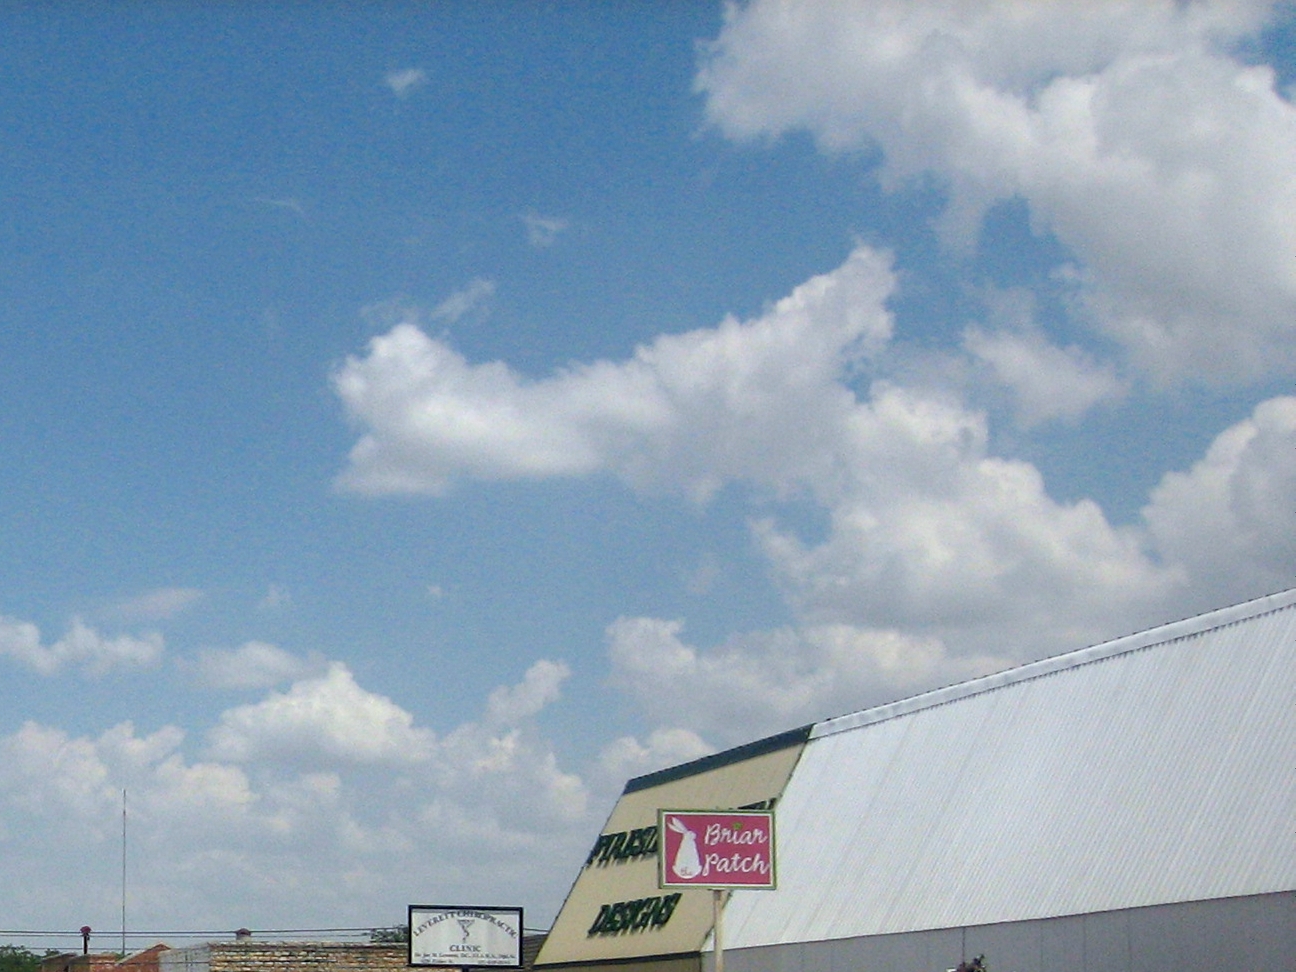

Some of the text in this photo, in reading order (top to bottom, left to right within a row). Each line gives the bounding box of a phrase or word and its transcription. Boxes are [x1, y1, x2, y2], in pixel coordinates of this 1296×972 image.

[704, 822, 768, 845] Briar
[413, 910, 518, 939] LEVERETT CHIROPRACTIC
[449, 944, 481, 952] CLINIC
